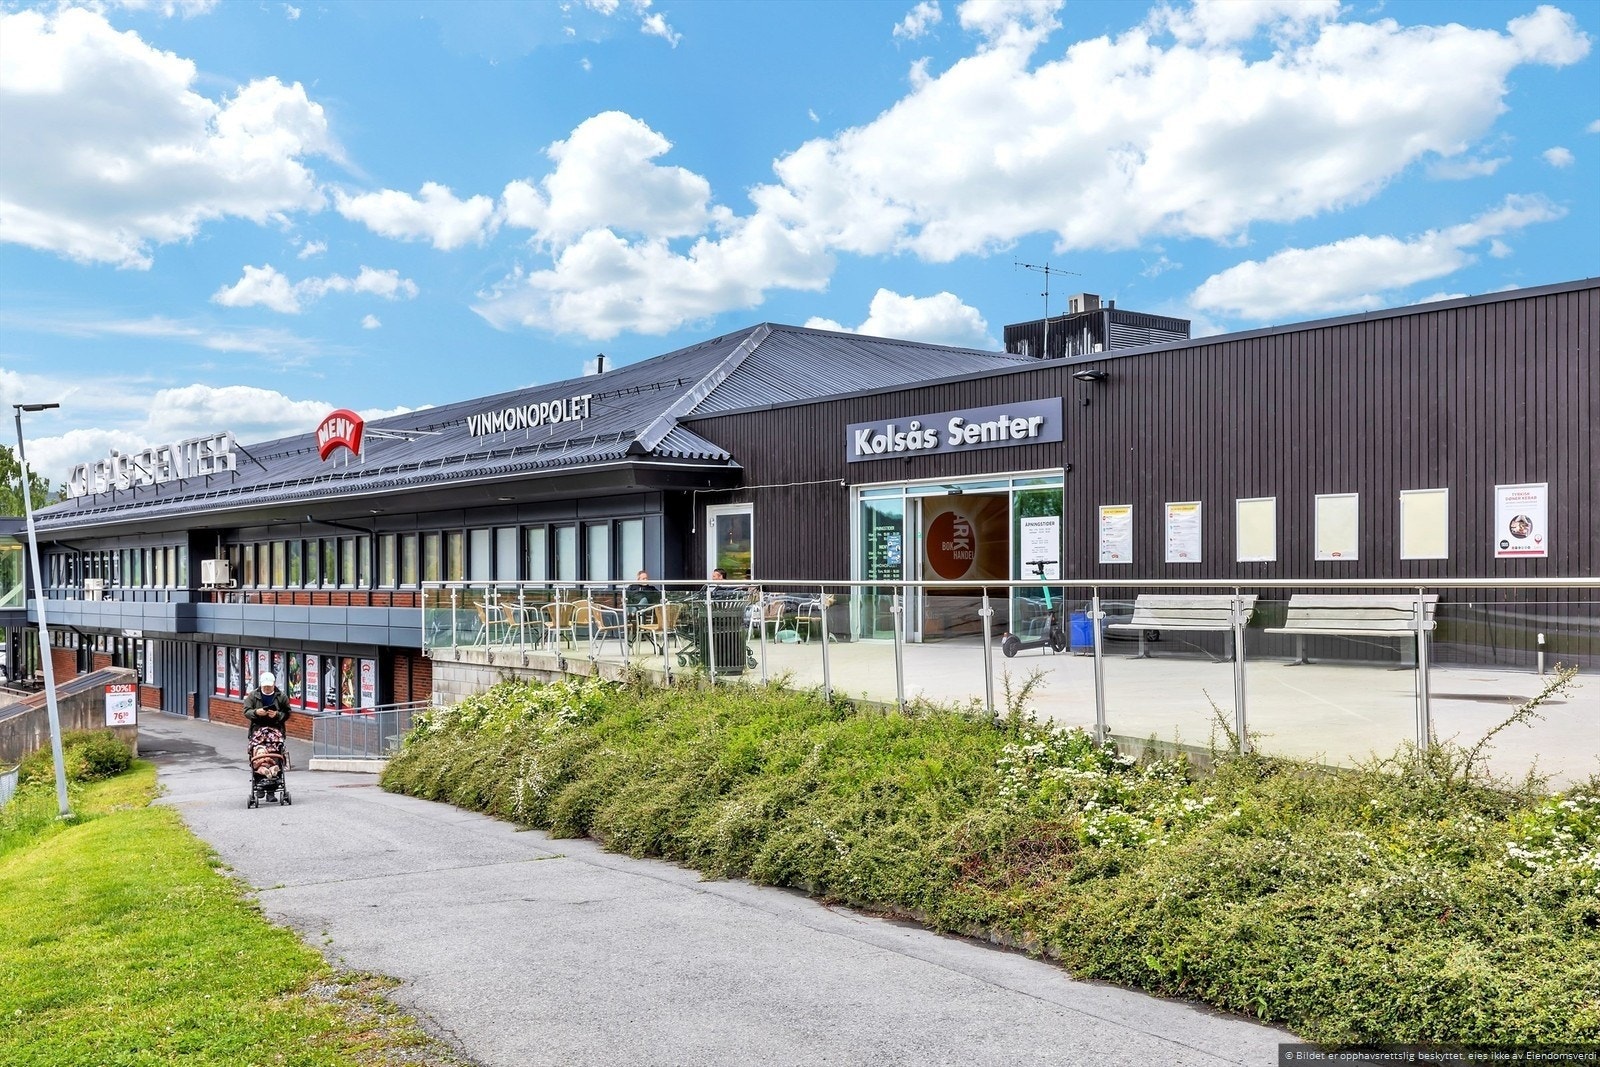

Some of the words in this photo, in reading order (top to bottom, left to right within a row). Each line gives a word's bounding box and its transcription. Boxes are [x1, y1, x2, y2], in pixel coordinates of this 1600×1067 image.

[318, 418, 355, 448] MENY
[467, 394, 592, 437] VINMONOPOLET
[855, 420, 938, 455] Kolsås
[948, 414, 1044, 446] Senter
[140, 430, 237, 486] SENTER
[942, 541, 954, 551] BOK
